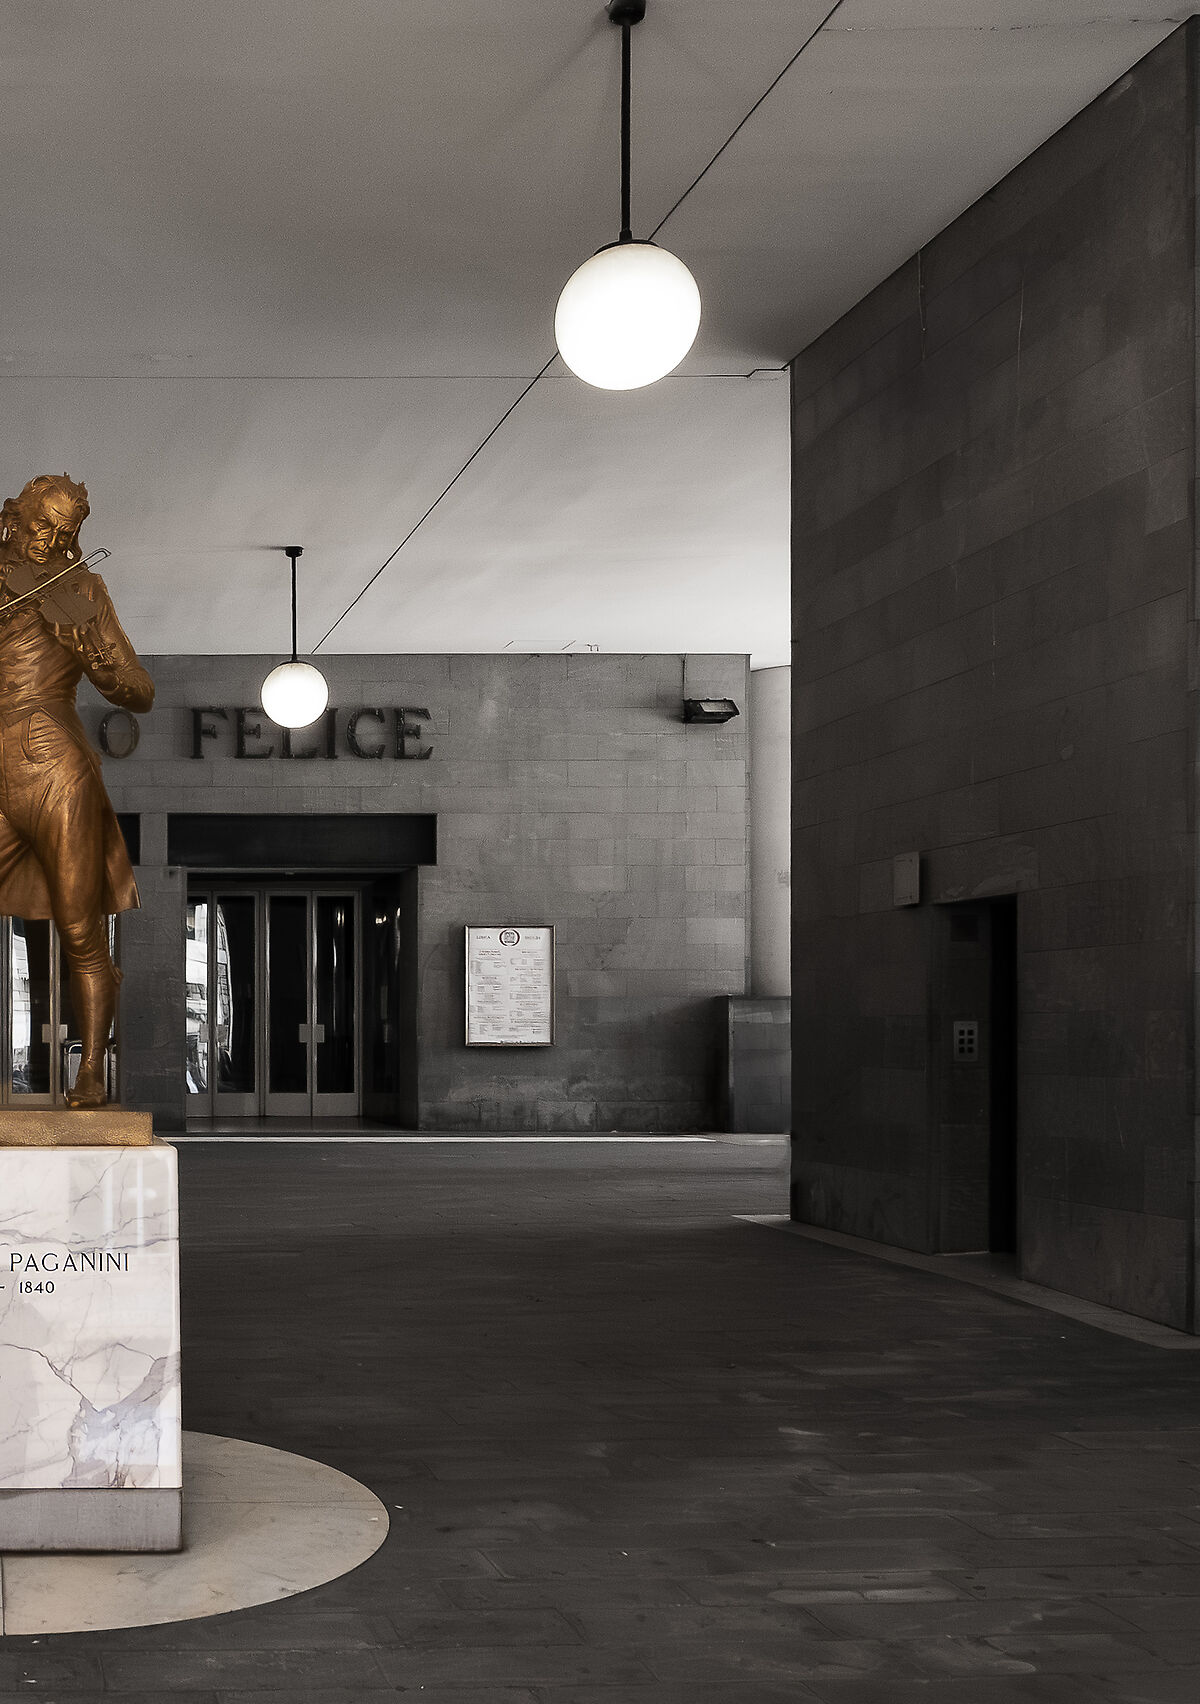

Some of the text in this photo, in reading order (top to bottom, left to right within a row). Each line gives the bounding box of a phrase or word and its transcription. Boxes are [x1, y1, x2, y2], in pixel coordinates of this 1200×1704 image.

[190, 706, 434, 760] FELICE
[10, 1252, 130, 1273] PAGANINI
[18, 1280, 56, 1294] 1840
